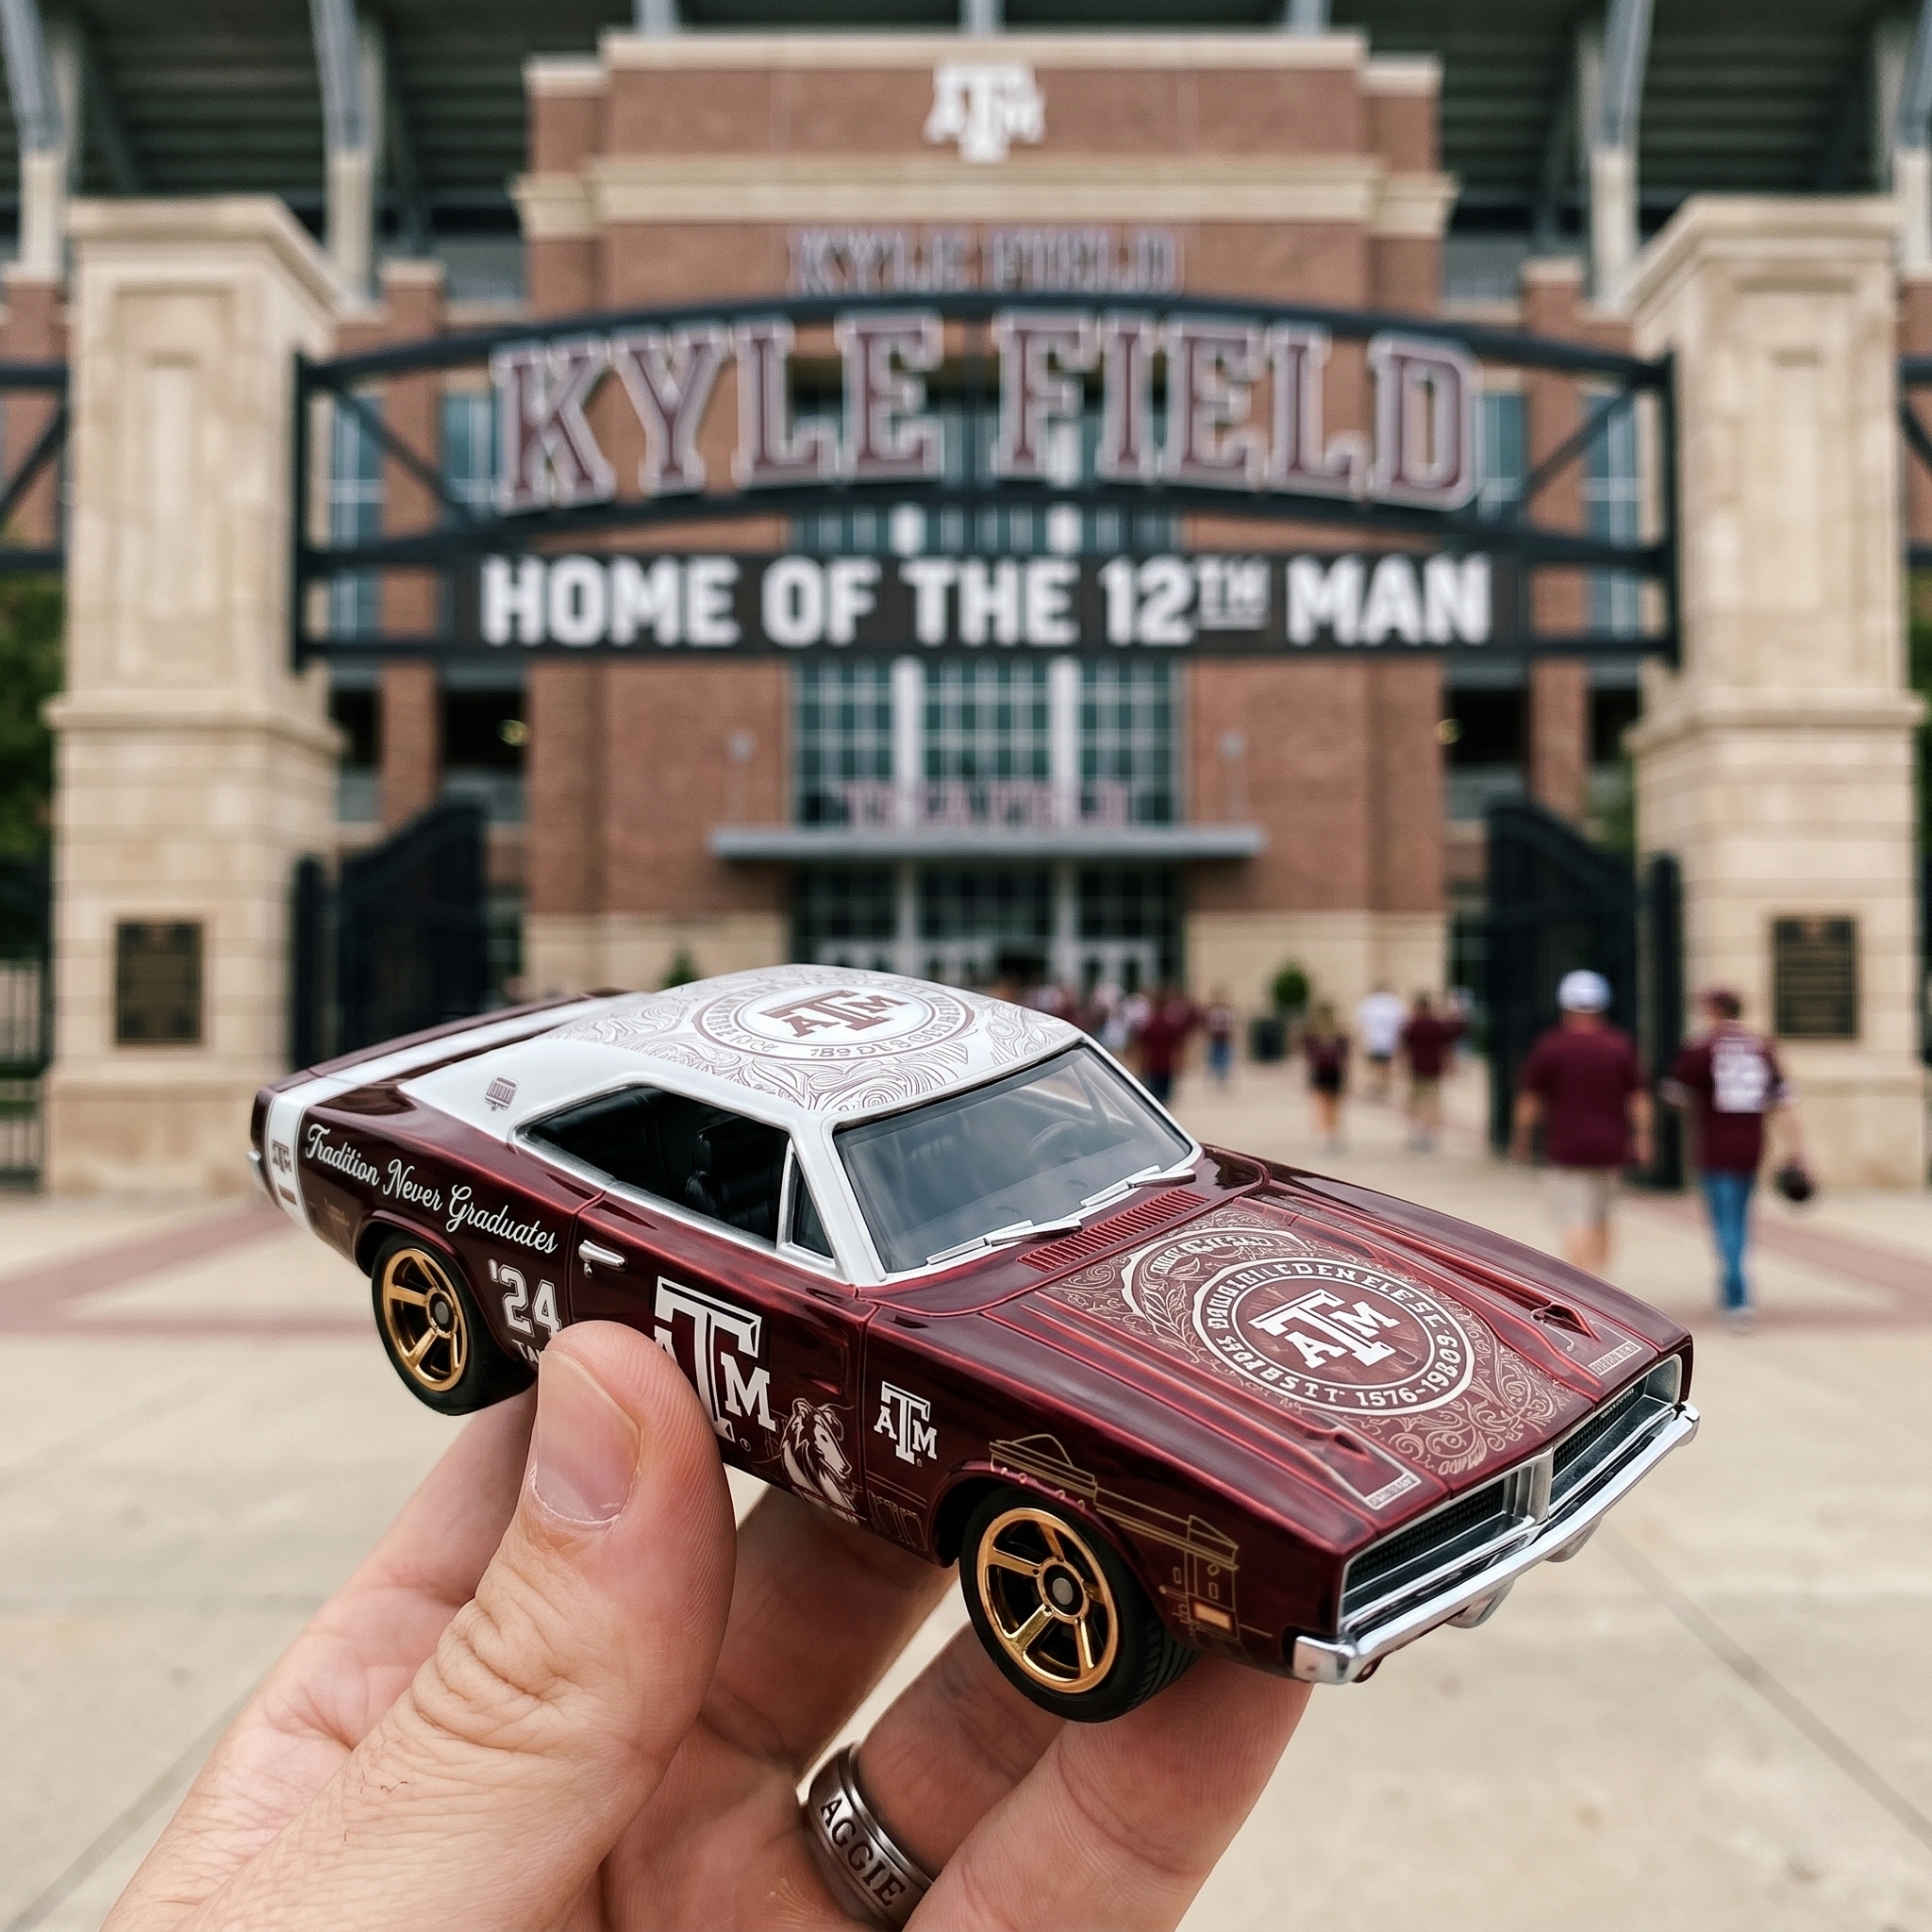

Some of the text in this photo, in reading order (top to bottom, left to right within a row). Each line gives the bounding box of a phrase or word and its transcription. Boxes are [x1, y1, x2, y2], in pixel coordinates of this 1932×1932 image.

[789, 228, 1184, 297] KYLE FIELD
[490, 308, 1482, 516] KYLE FIELD
[480, 555, 742, 648] HOME
[761, 555, 882, 648] OF
[899, 555, 1082, 648] THE
[1286, 551, 1492, 648] MAN
[305, 1123, 558, 1254] Tradition Never Graduates
[820, 1798, 907, 1907] AGGIE
